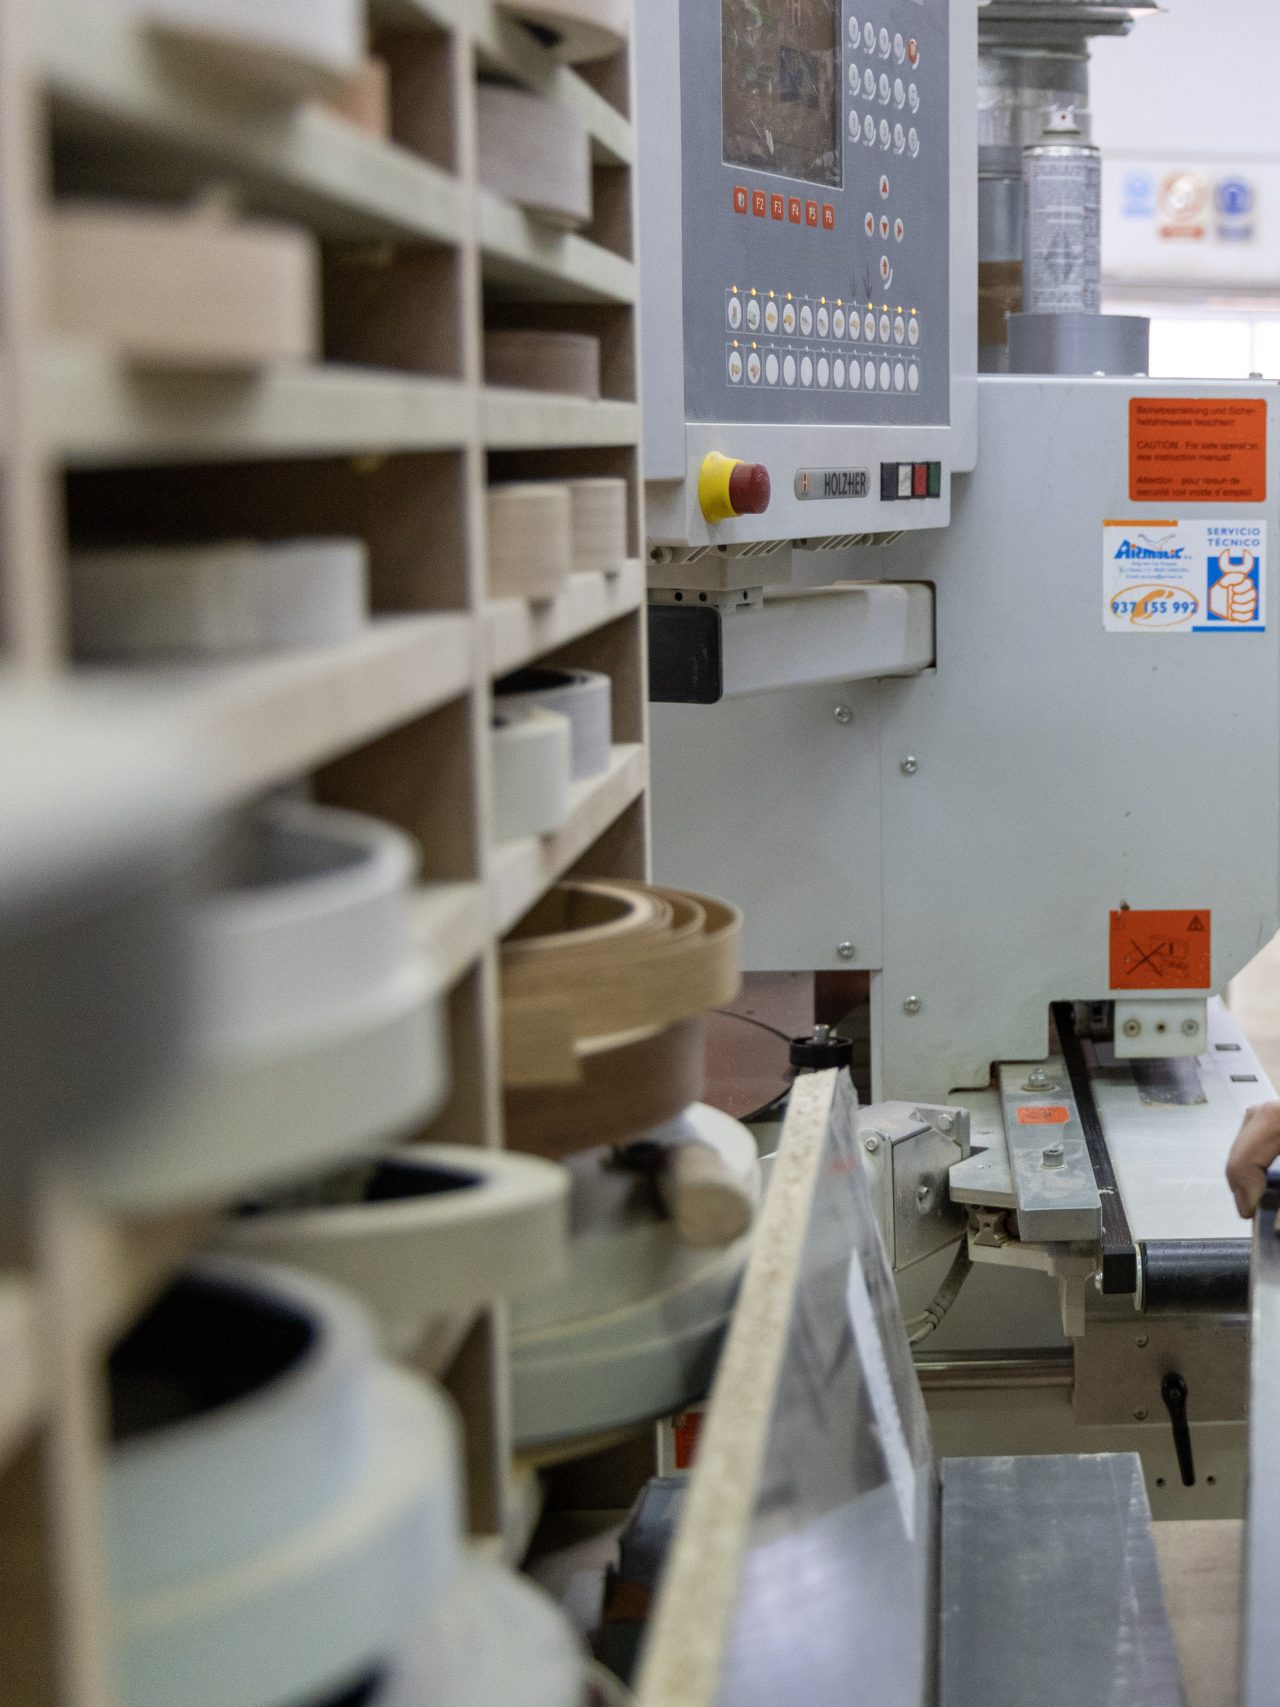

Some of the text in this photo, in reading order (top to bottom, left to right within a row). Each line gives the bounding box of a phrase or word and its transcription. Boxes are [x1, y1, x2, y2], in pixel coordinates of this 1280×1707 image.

[756, 197, 764, 211] F2
[774, 200, 782, 214] F3
[791, 203, 799, 217] F4
[825, 210, 833, 224] F6
[1136, 440, 1178, 450] CAUTION
[1185, 441, 1198, 449] For
[1207, 527, 1261, 536] SERVICIO
[1112, 601, 1198, 614] 937 155 992
